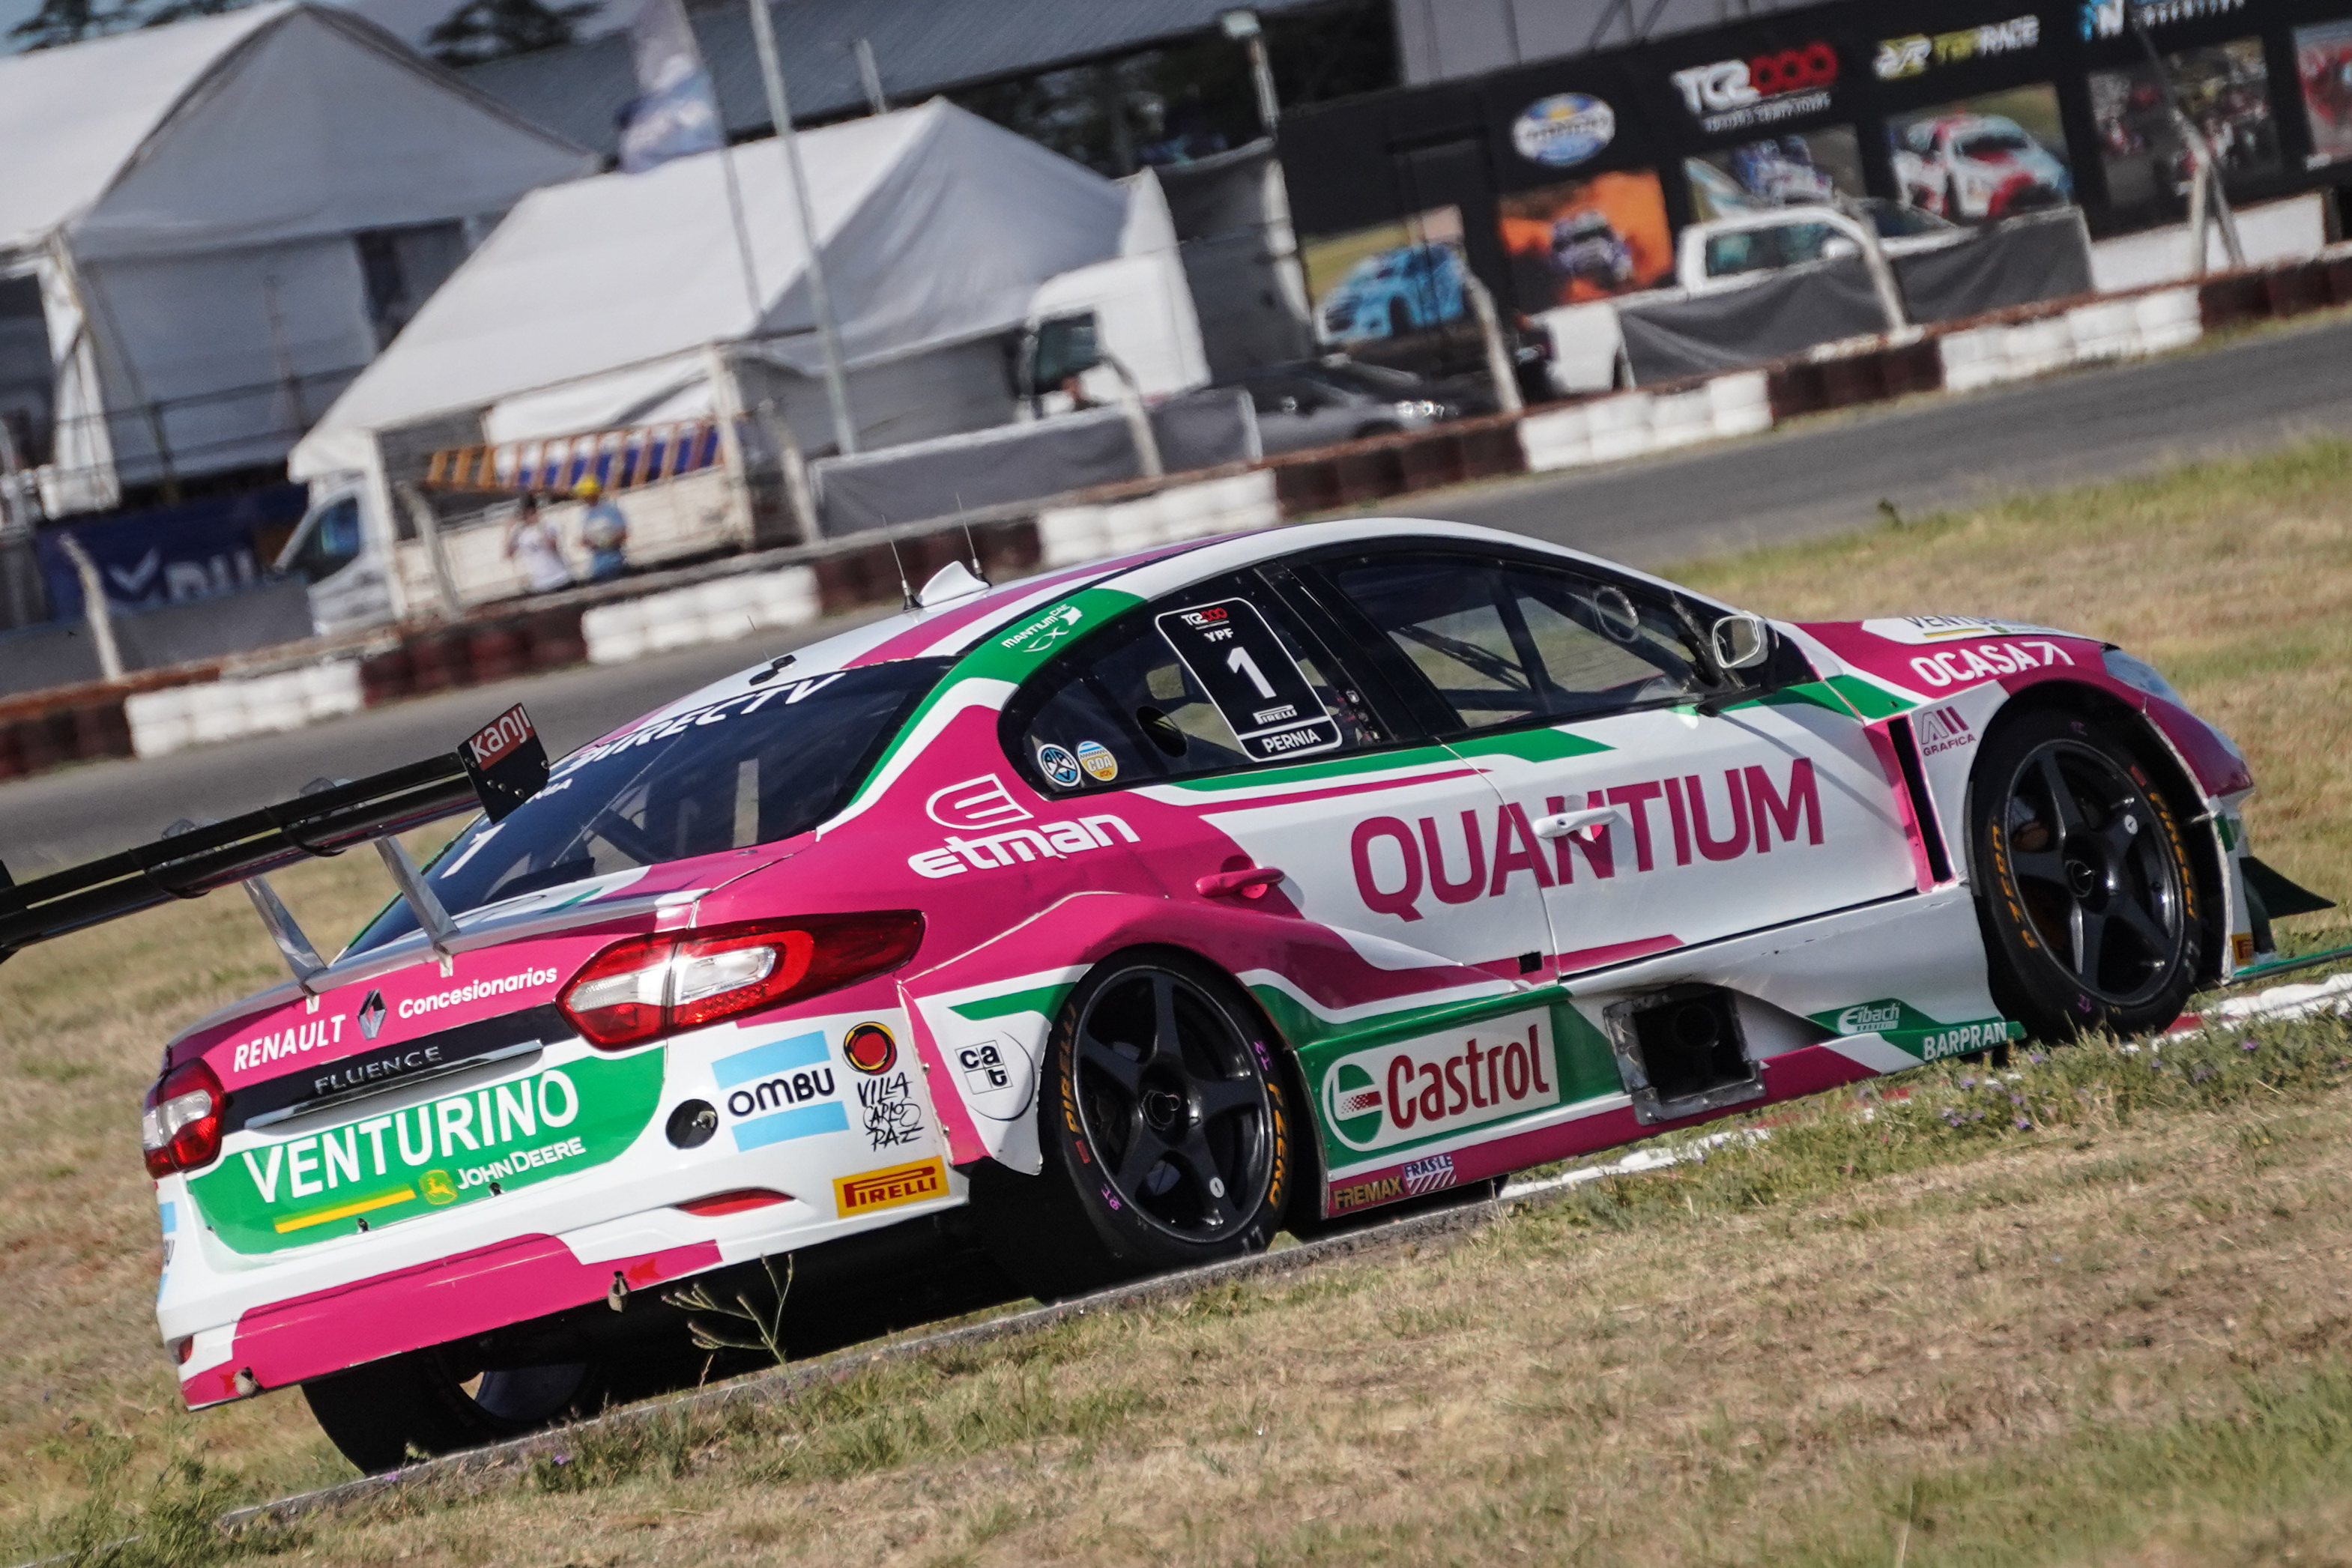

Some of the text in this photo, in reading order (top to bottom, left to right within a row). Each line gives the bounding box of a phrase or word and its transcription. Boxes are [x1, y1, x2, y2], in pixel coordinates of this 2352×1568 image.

[1181, 608, 1228, 626] TC2000
[1204, 628, 1233, 642] YPF
[1227, 647, 1277, 698] 1
[1253, 704, 1297, 724] PIRELLI
[1262, 729, 1322, 753] PERNIA
[1923, 733, 1977, 756] GRAFICA
[1087, 755, 1113, 772] CDA
[907, 814, 1140, 879] etman
[1350, 757, 1824, 922] QUANTIUM
[399, 967, 557, 1019] Concesionarios
[233, 1014, 346, 1072] RENAULT
[1923, 1022, 2007, 1061] BARPRAN
[314, 1047, 444, 1094] FLUENCE
[857, 1072, 913, 1107] VILLA
[1388, 1024, 1550, 1130] Castrol
[728, 1068, 835, 1117] OMBU
[863, 1097, 922, 1130] CARLOS
[242, 1069, 579, 1204] VENTURINO
[865, 1127, 925, 1152] PAZ
[457, 1136, 584, 1190] JOHN DEERE
[844, 1166, 937, 1208] PIRELLI
[1333, 1175, 1403, 1209] FREMAX
